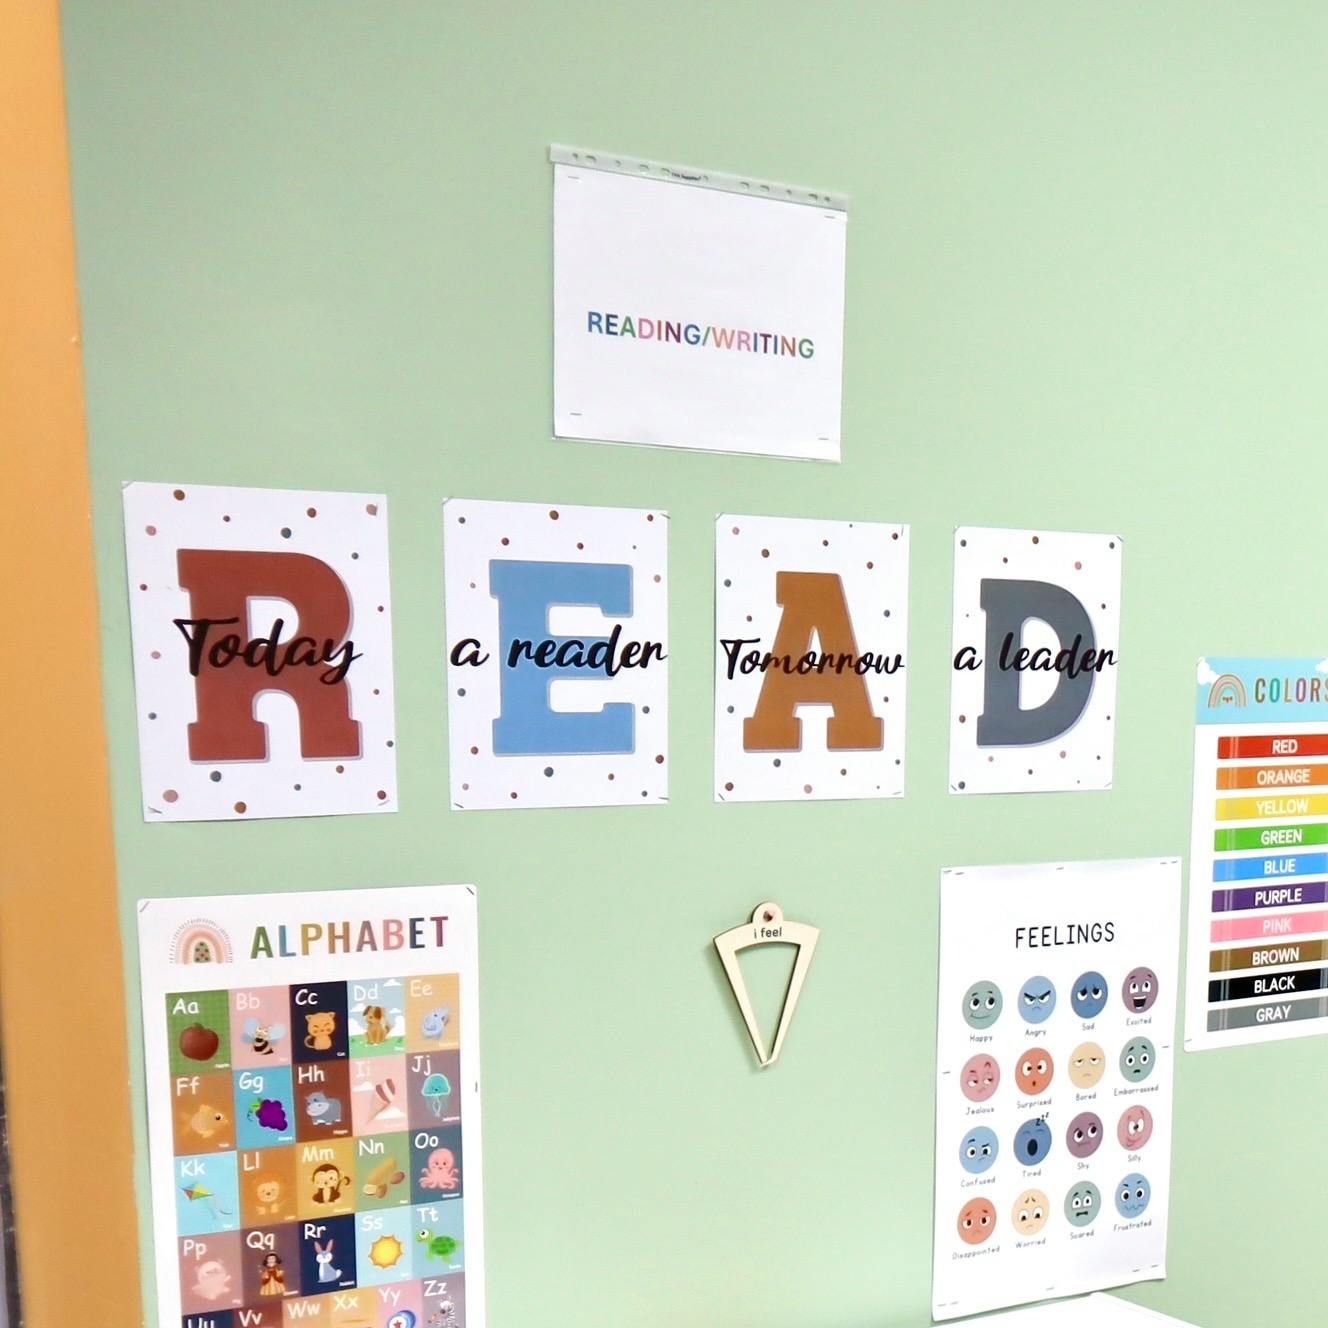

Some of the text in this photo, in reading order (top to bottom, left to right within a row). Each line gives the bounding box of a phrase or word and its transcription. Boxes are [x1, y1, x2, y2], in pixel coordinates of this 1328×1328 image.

[586, 311, 815, 359] READING/WRITING
[173, 616, 363, 684] Today
[176, 548, 363, 763] R
[450, 624, 667, 676] a reader
[489, 559, 634, 757] E
[954, 632, 1117, 679] a leader
[719, 638, 905, 680] Tomorrow
[743, 571, 884, 752] A
[976, 578, 1096, 748] D
[1272, 739, 1298, 754] RED
[1257, 769, 1310, 785] ORANGE
[1256, 799, 1309, 815] YELLOW
[1261, 829, 1302, 844] GREEN
[1264, 859, 1296, 874] BLUE
[1255, 888, 1302, 906] PURPLE
[754, 926, 782, 938] i feel
[1263, 919, 1292, 933] PINK
[250, 916, 449, 959] ALPHABET
[1015, 922, 1115, 948] FEELINGS
[1253, 947, 1299, 966] BROWN
[354, 984, 378, 1000] Dd
[1254, 976, 1295, 993] BLACK
[295, 990, 318, 1006] Cc
[172, 999, 199, 1015] Aa
[1256, 1005, 1292, 1022] GRAY
[1082, 1023, 1094, 1031] Sad
[1126, 1018, 1151, 1026] Excited
[969, 1035, 992, 1043] Happy
[411, 1055, 432, 1076] Jj
[239, 1073, 263, 1092] Gg
[298, 1067, 324, 1083] Hh
[176, 1077, 199, 1096] Ff
[1114, 1085, 1159, 1096] Embarrassed
[1017, 1099, 1051, 1109] Surprised
[1076, 1093, 1096, 1101] Bored
[359, 1139, 384, 1156] Nn
[415, 1133, 438, 1148] Oo
[302, 1146, 334, 1163] Mm
[181, 1160, 205, 1177] Kk
[1023, 1169, 1041, 1177] Tired
[1077, 1162, 1089, 1171] Shy
[961, 1177, 995, 1188] Confused
[416, 1207, 439, 1223] Tt
[304, 1224, 326, 1239] Rr
[1114, 1220, 1152, 1232] Frustrated
[247, 1232, 275, 1249] Qq
[1016, 1238, 1046, 1249] Worried
[183, 1239, 206, 1259] Pp
[952, 1246, 1000, 1260] Disappointed
[424, 1280, 447, 1296] Zz
[239, 1310, 262, 1327] Vv
